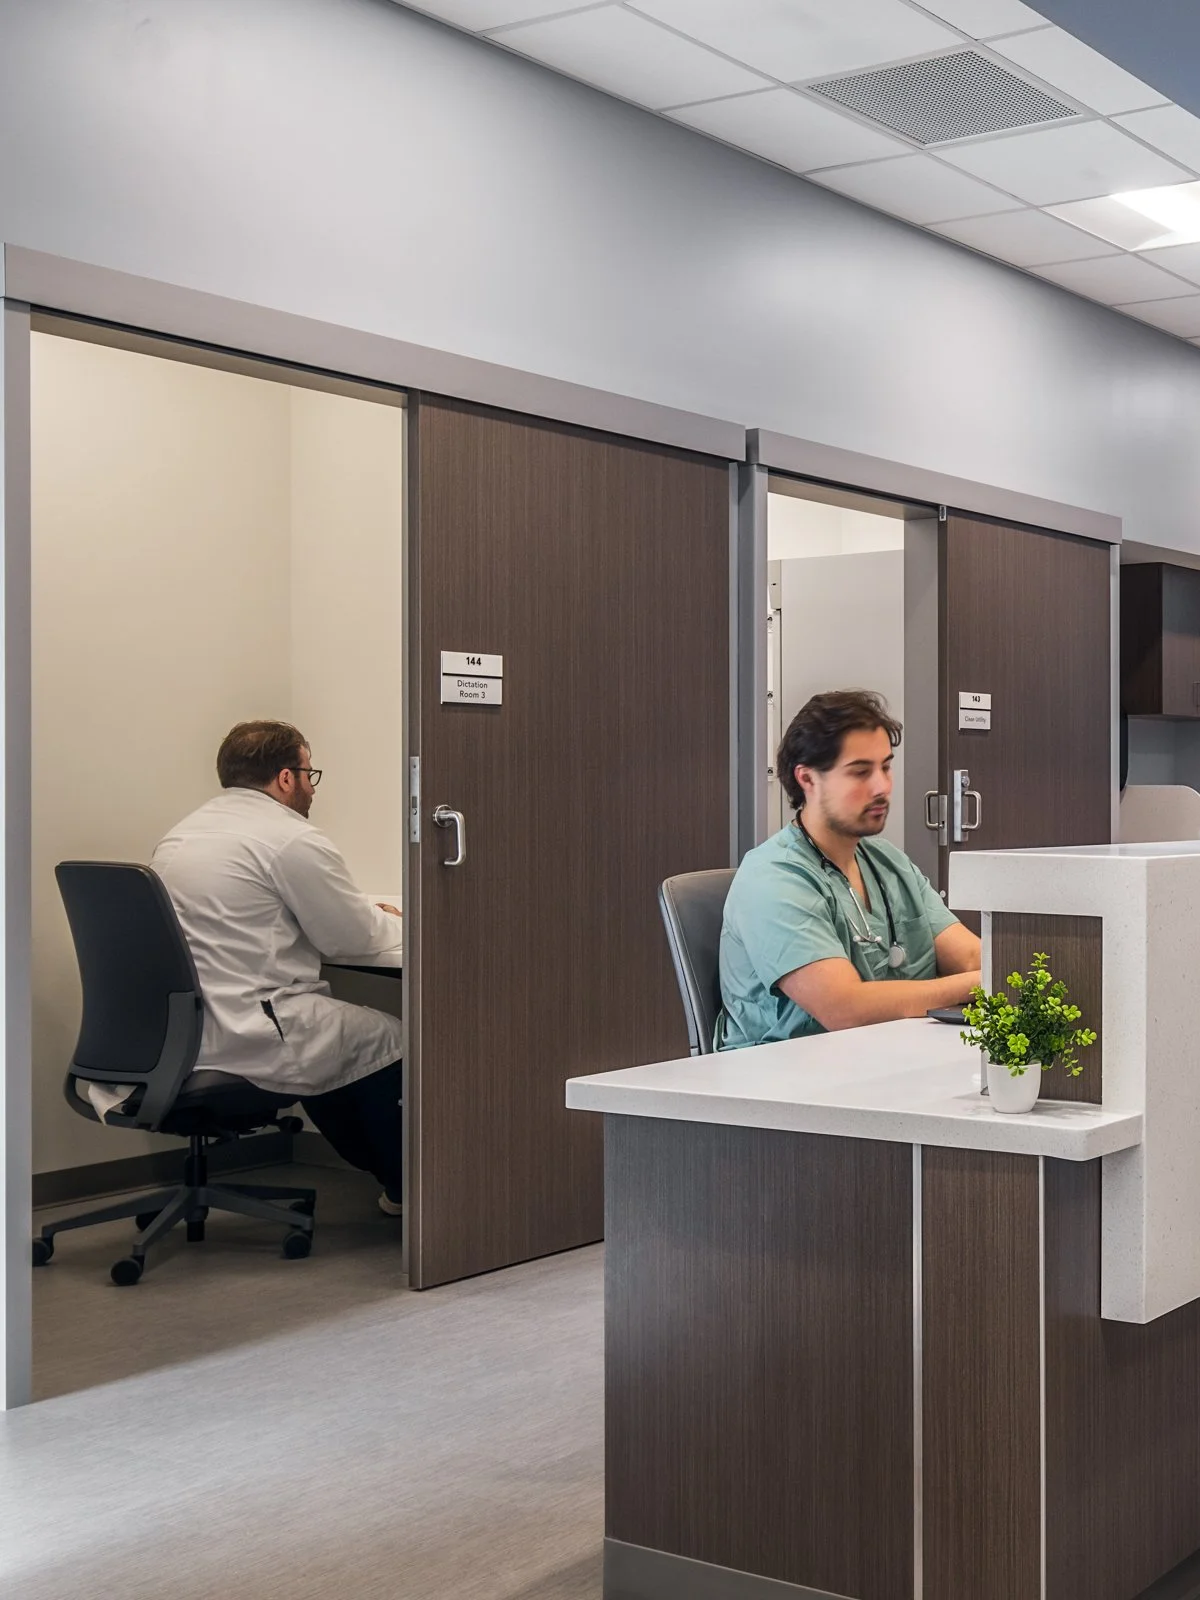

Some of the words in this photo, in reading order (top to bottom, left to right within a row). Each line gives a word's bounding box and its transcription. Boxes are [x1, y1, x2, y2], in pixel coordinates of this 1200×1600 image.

[466, 656, 482, 666] 144
[457, 679, 488, 689] Dictation
[459, 690, 480, 698] Room
[481, 691, 486, 699] 3
[972, 695, 981, 703] 143
